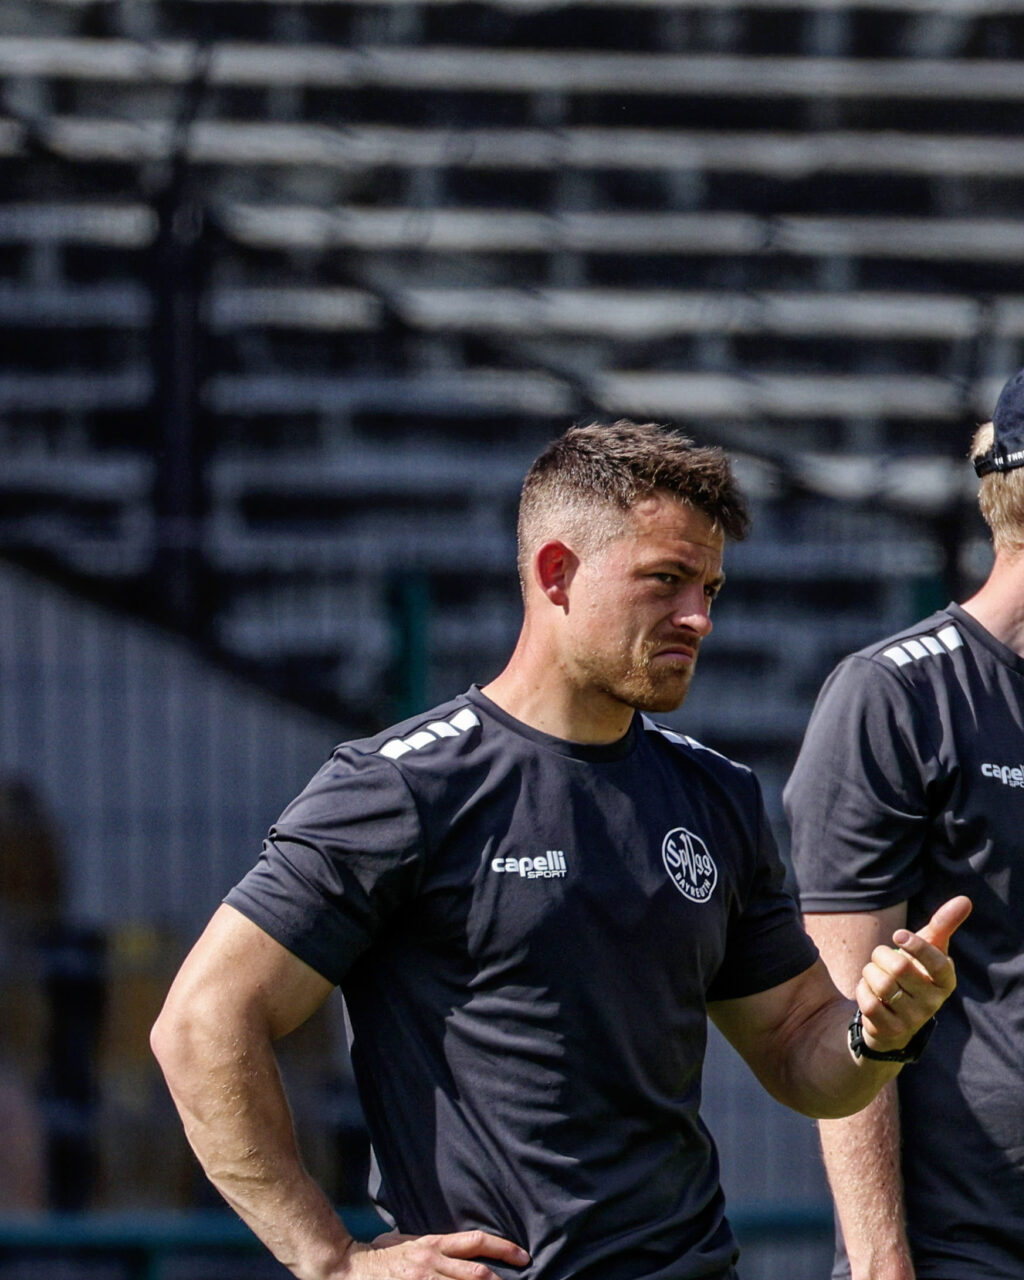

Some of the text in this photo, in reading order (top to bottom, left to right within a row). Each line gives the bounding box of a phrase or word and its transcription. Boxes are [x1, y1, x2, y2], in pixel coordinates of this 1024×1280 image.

[491, 850, 567, 877] capelli
[527, 869, 567, 879] SPORT
[675, 871, 712, 898] BAYREUTH
